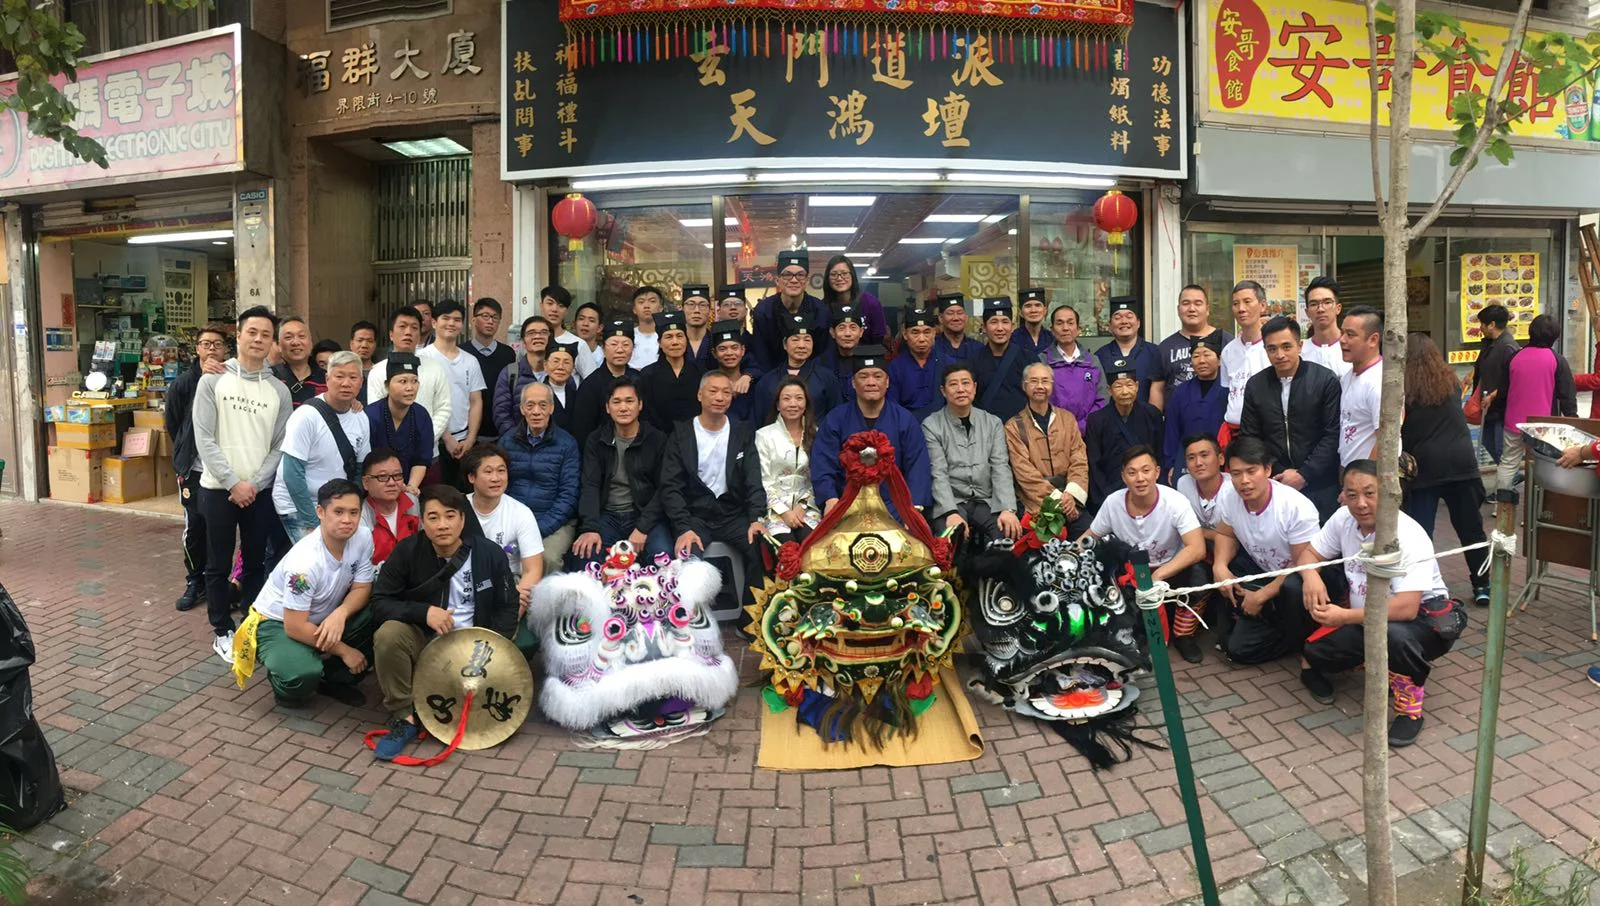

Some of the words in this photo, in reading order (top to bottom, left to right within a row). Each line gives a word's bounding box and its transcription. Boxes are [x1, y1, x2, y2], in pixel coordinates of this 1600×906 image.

[690, 30, 1004, 90] 玄門道派
[1220, 7, 1260, 101] 安哥食館
[28, 52, 236, 139] 碼電子城
[513, 51, 537, 157] 扶乩問事
[1151, 55, 1173, 157] 功德法事
[190, 118, 232, 149] CITY
[727, 89, 972, 147] 天鴻壇
[240, 191, 266, 200] CASIO
[249, 288, 261, 297] 6A
[521, 296, 528, 305] 6
[223, 395, 268, 408] AMERICAN
[232, 404, 257, 415] EAGLE
